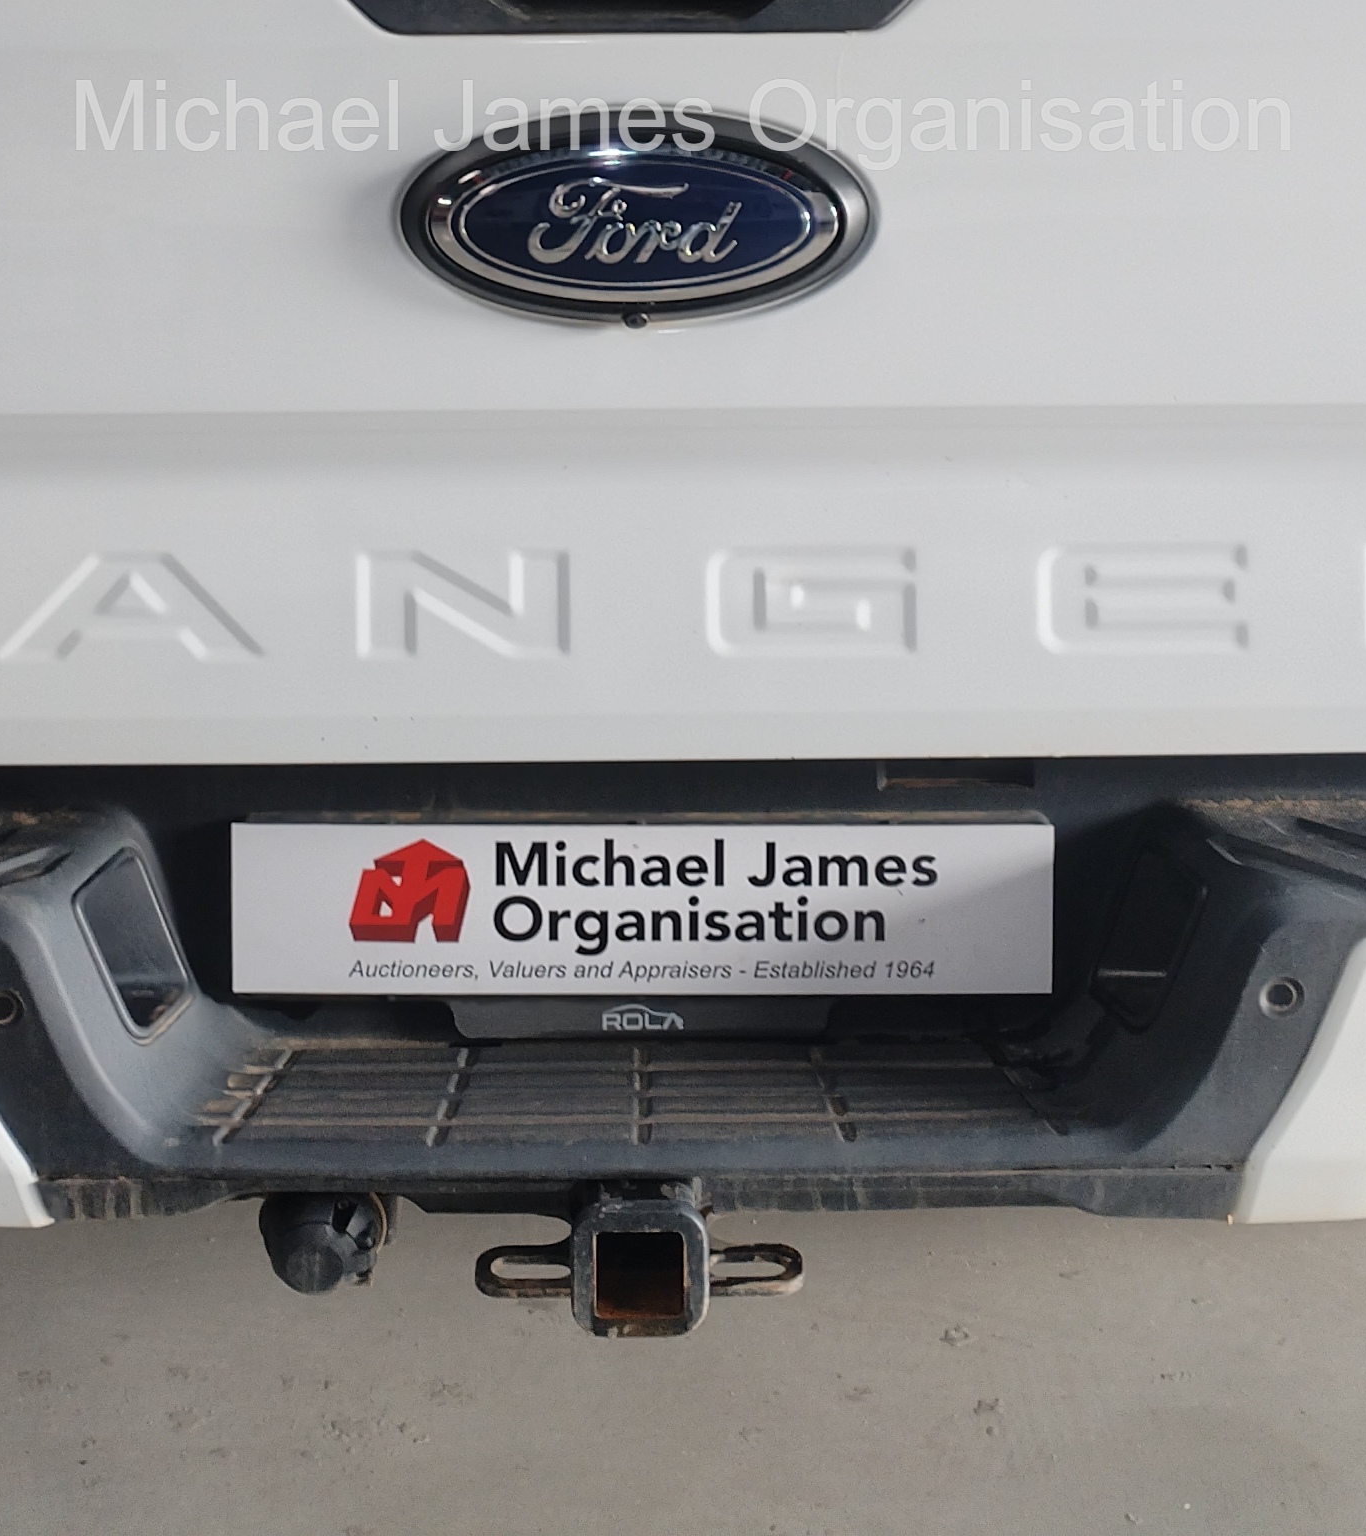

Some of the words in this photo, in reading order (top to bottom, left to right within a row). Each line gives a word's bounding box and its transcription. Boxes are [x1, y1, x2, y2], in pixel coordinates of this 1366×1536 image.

[527, 174, 741, 266] Ford
[494, 838, 726, 889] Michael
[747, 840, 939, 889] James
[493, 894, 886, 955] Organisation
[349, 959, 480, 983] Auctioneers,
[488, 959, 568, 979] Valuers
[573, 959, 614, 979] and
[618, 959, 732, 984] Appraisers
[753, 959, 879, 980] Established
[884, 960, 936, 979] 1964
[602, 1010, 684, 1032] ROLA
